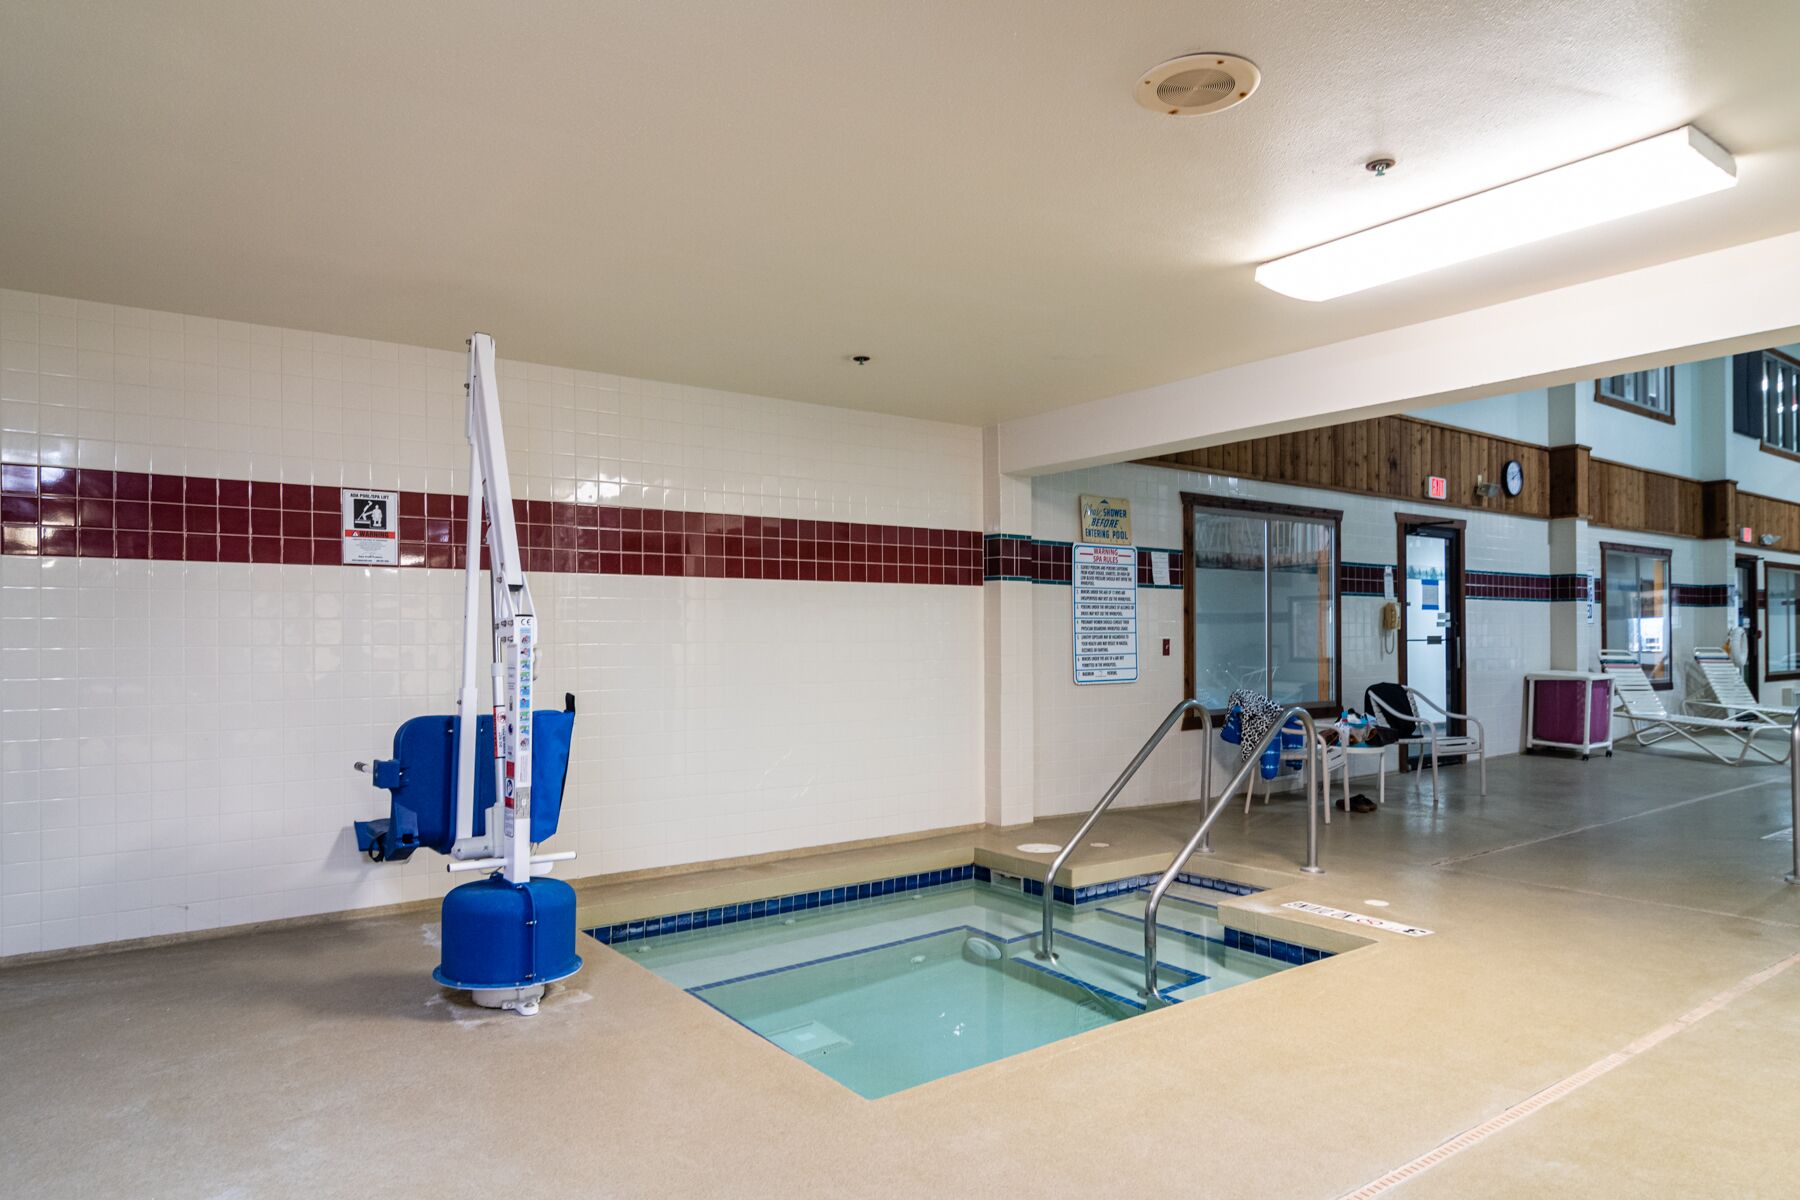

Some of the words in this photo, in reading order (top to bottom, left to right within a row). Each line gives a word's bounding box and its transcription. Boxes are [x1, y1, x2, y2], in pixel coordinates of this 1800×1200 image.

[1431, 479, 1444, 496] EXIT
[1103, 508, 1127, 518] SHOWER
[1092, 518, 1119, 528] BEFORE
[1085, 528, 1109, 538] ENTERING
[1113, 530, 1128, 539] POOL
